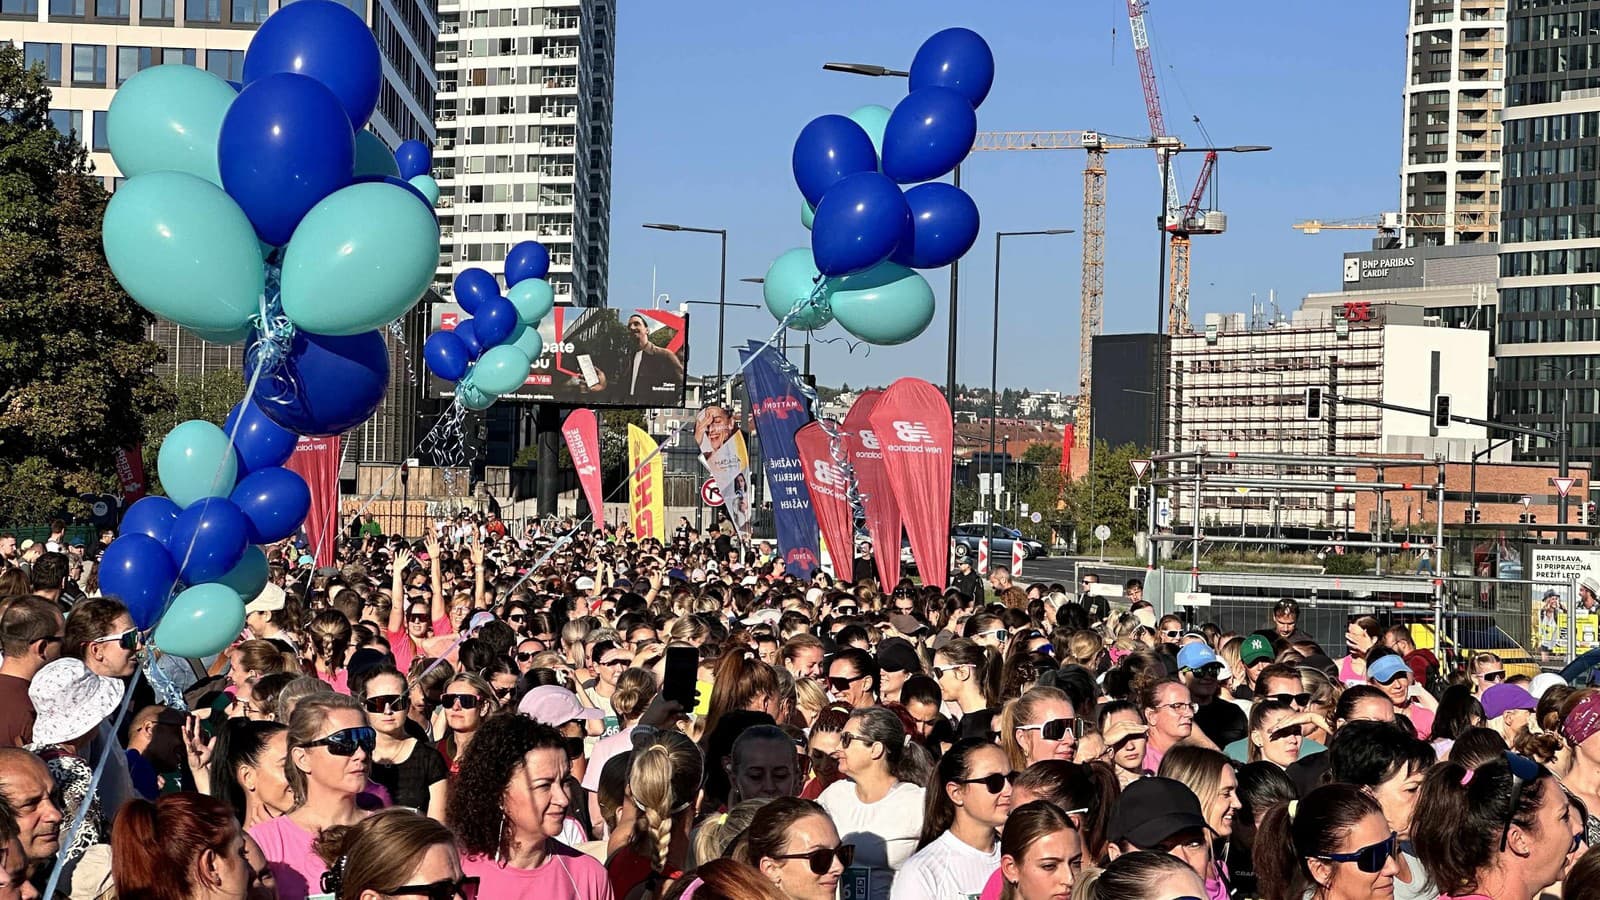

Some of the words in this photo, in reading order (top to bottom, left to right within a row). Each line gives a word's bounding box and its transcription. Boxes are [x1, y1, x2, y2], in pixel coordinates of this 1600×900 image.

[1362, 260, 1379, 269] BNP
[1380, 257, 1414, 268] PARIBAS
[1362, 268, 1389, 278] CARDIF
[1252, 640, 1262, 649] NY
